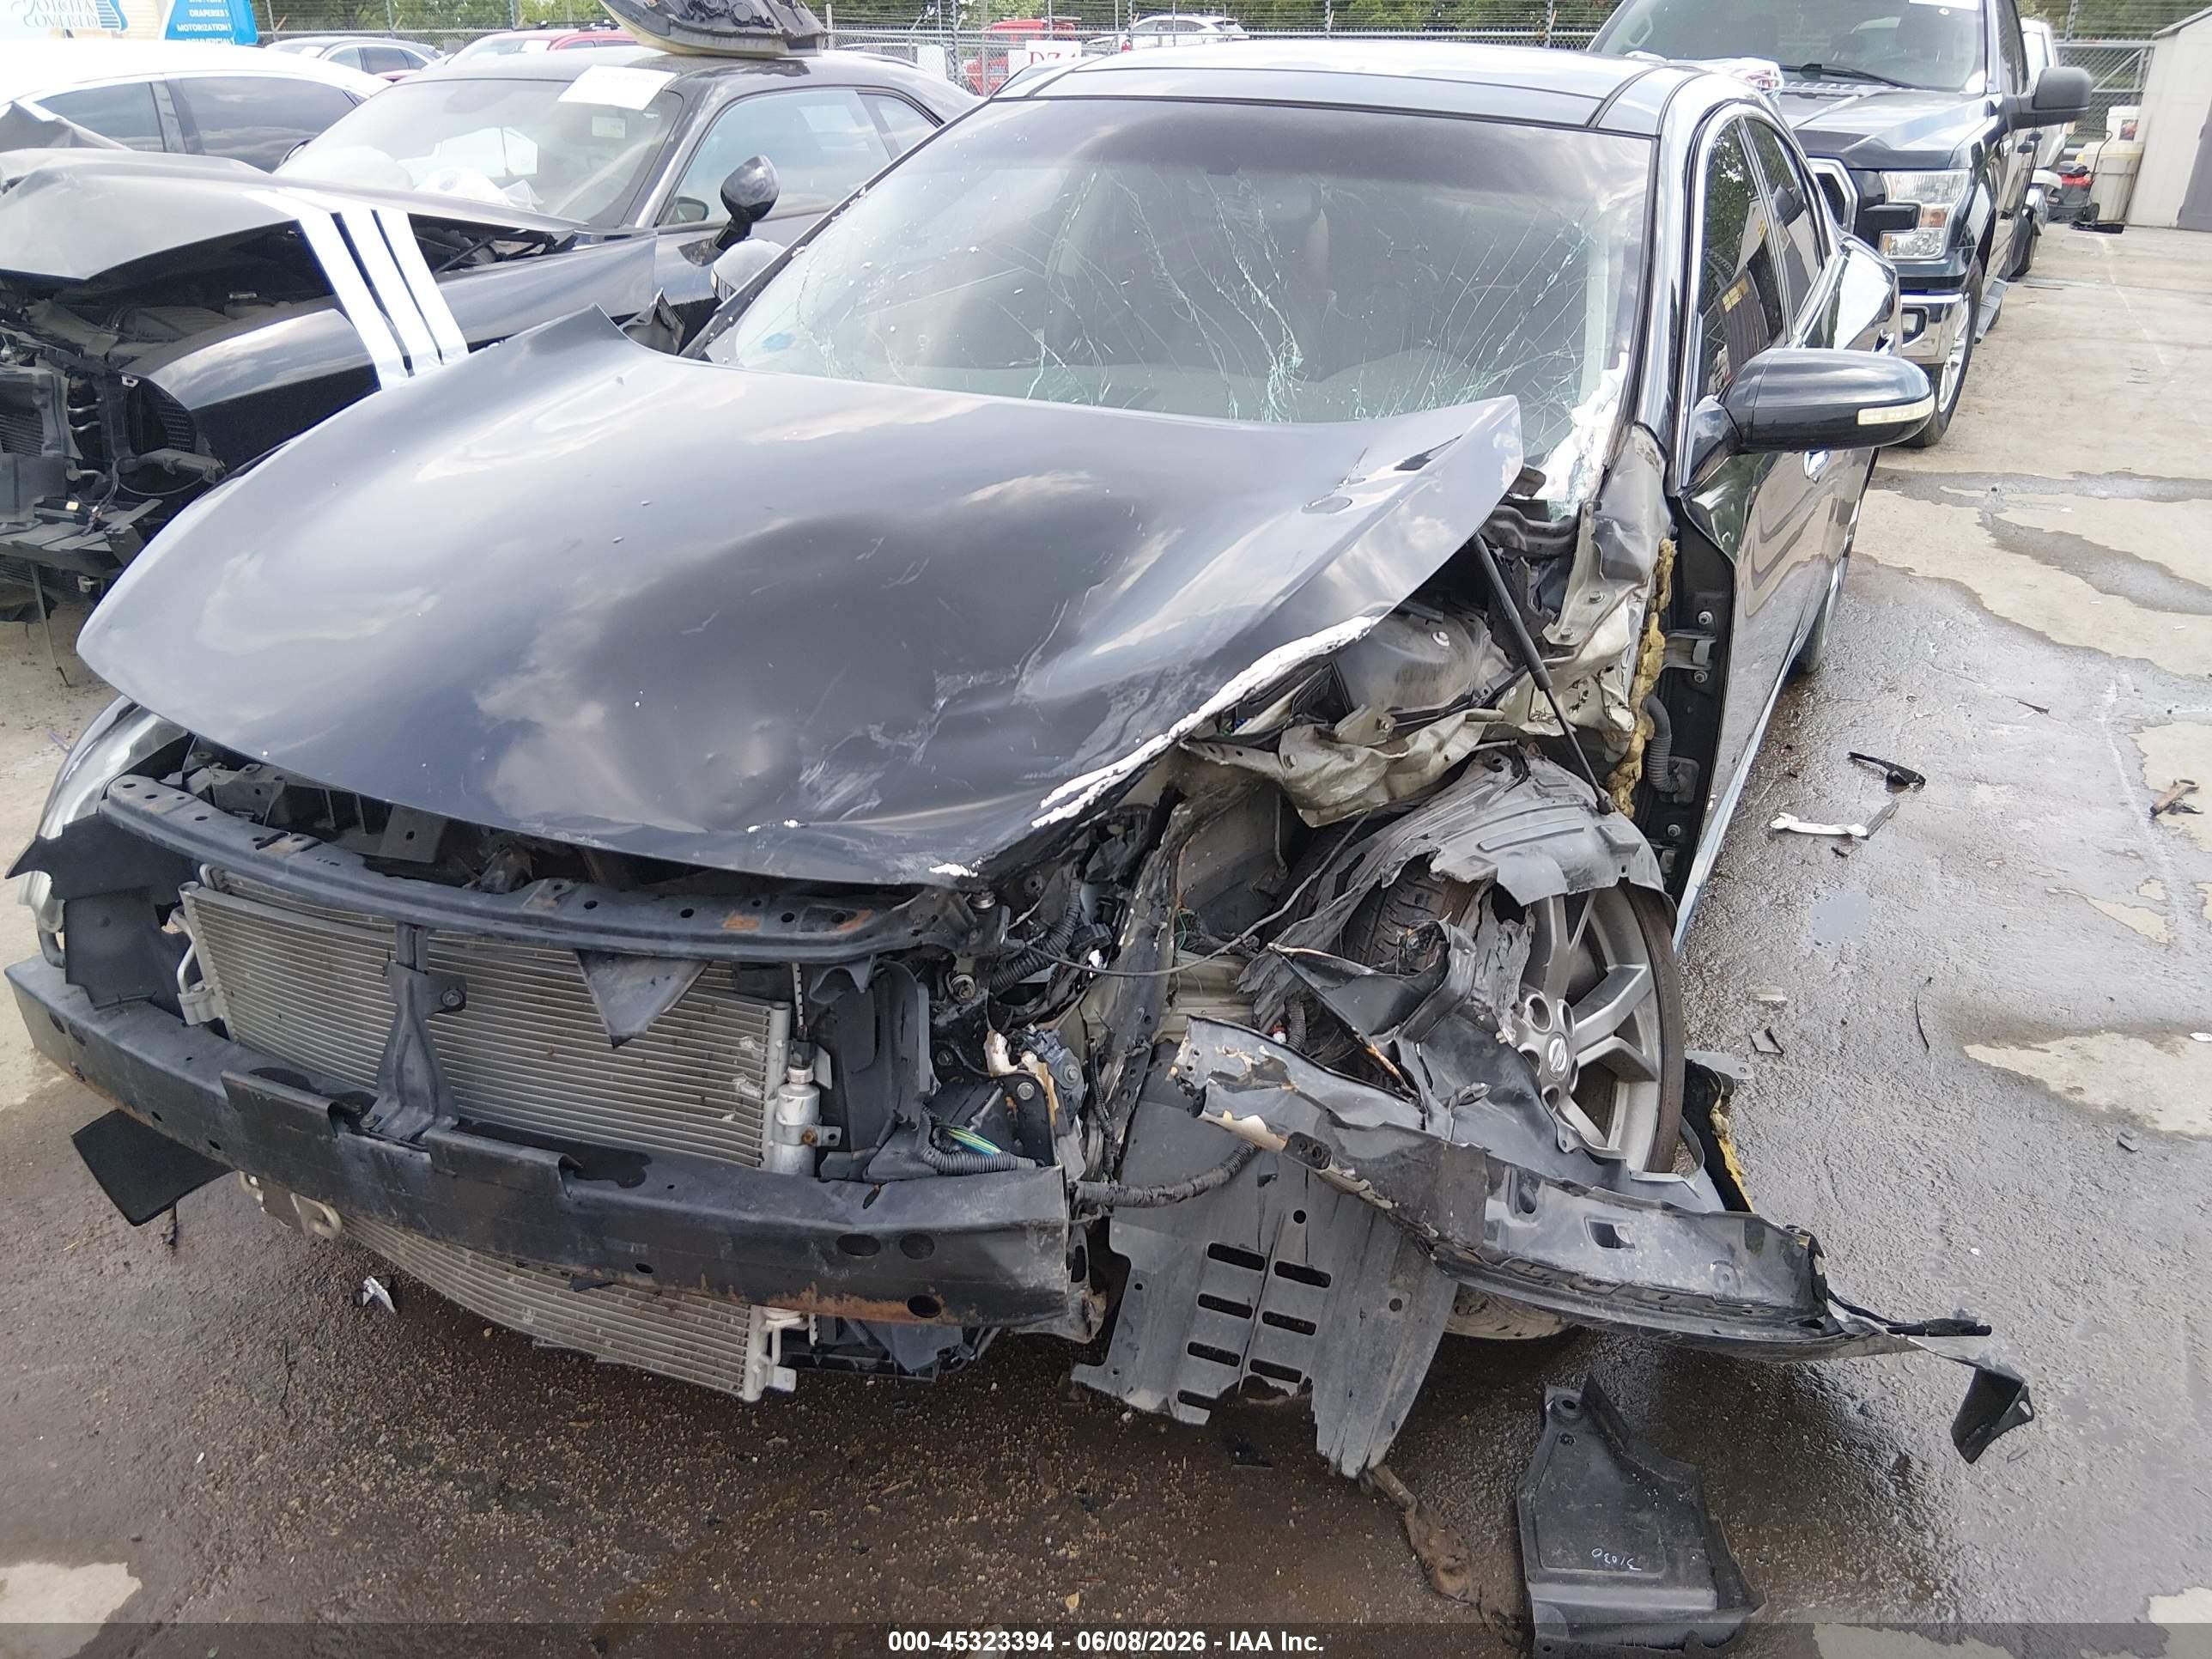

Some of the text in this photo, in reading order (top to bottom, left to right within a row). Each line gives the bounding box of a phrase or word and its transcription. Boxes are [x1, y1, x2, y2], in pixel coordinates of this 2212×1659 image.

[188, 9, 225, 18] DRAPERIES
[23, 15, 98, 28] COVERED
[176, 23, 228, 32] MOTORIZATION
